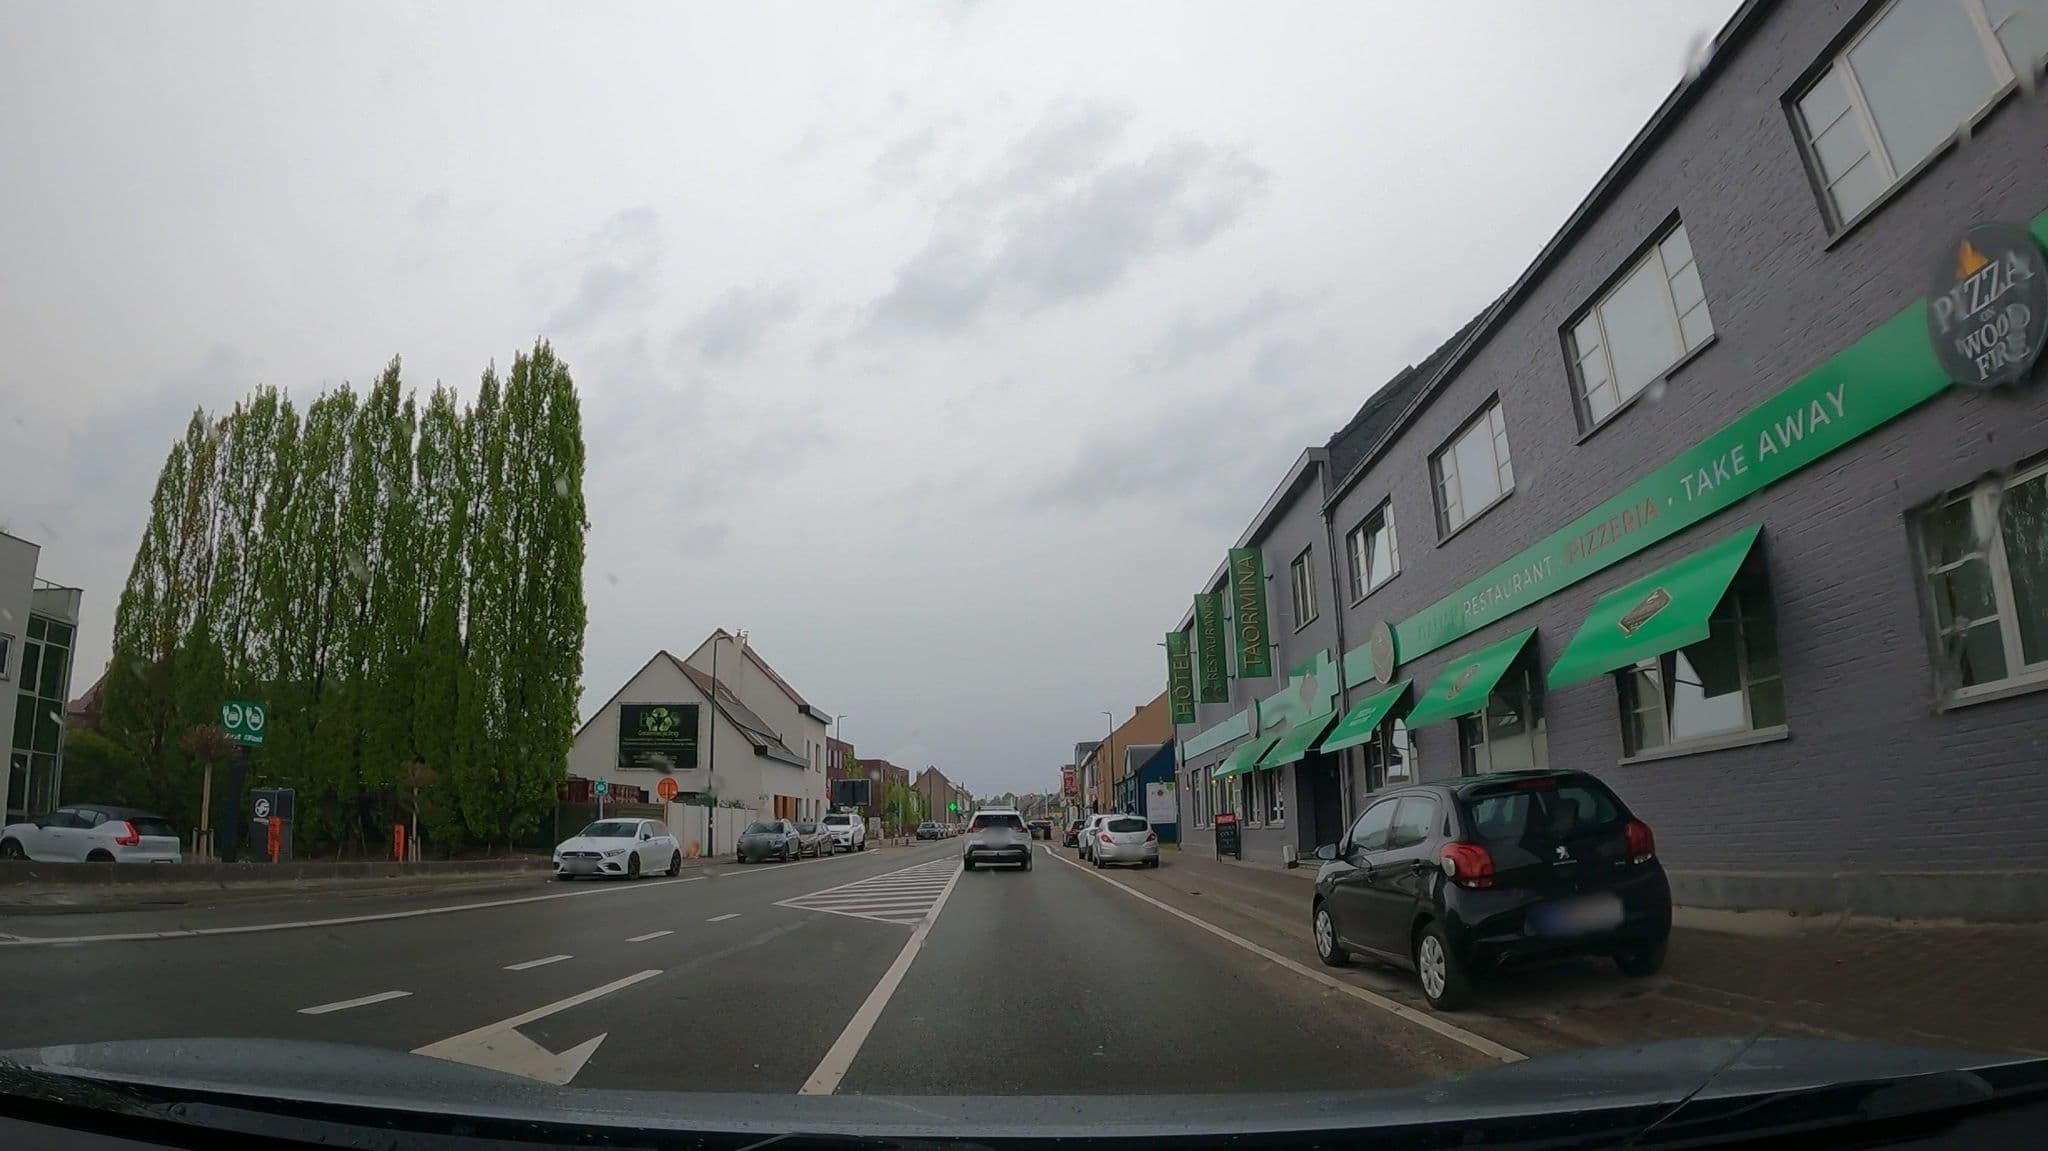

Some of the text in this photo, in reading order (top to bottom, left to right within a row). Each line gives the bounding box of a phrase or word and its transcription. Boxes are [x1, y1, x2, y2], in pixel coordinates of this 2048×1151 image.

[1933, 249, 2035, 334] PIZZA
[1955, 303, 2031, 359] WOOD
[1463, 383, 1845, 618] RESTAURANT PIZZERIA TAKE AWAY
[1238, 555, 1265, 669] TAORMINA
